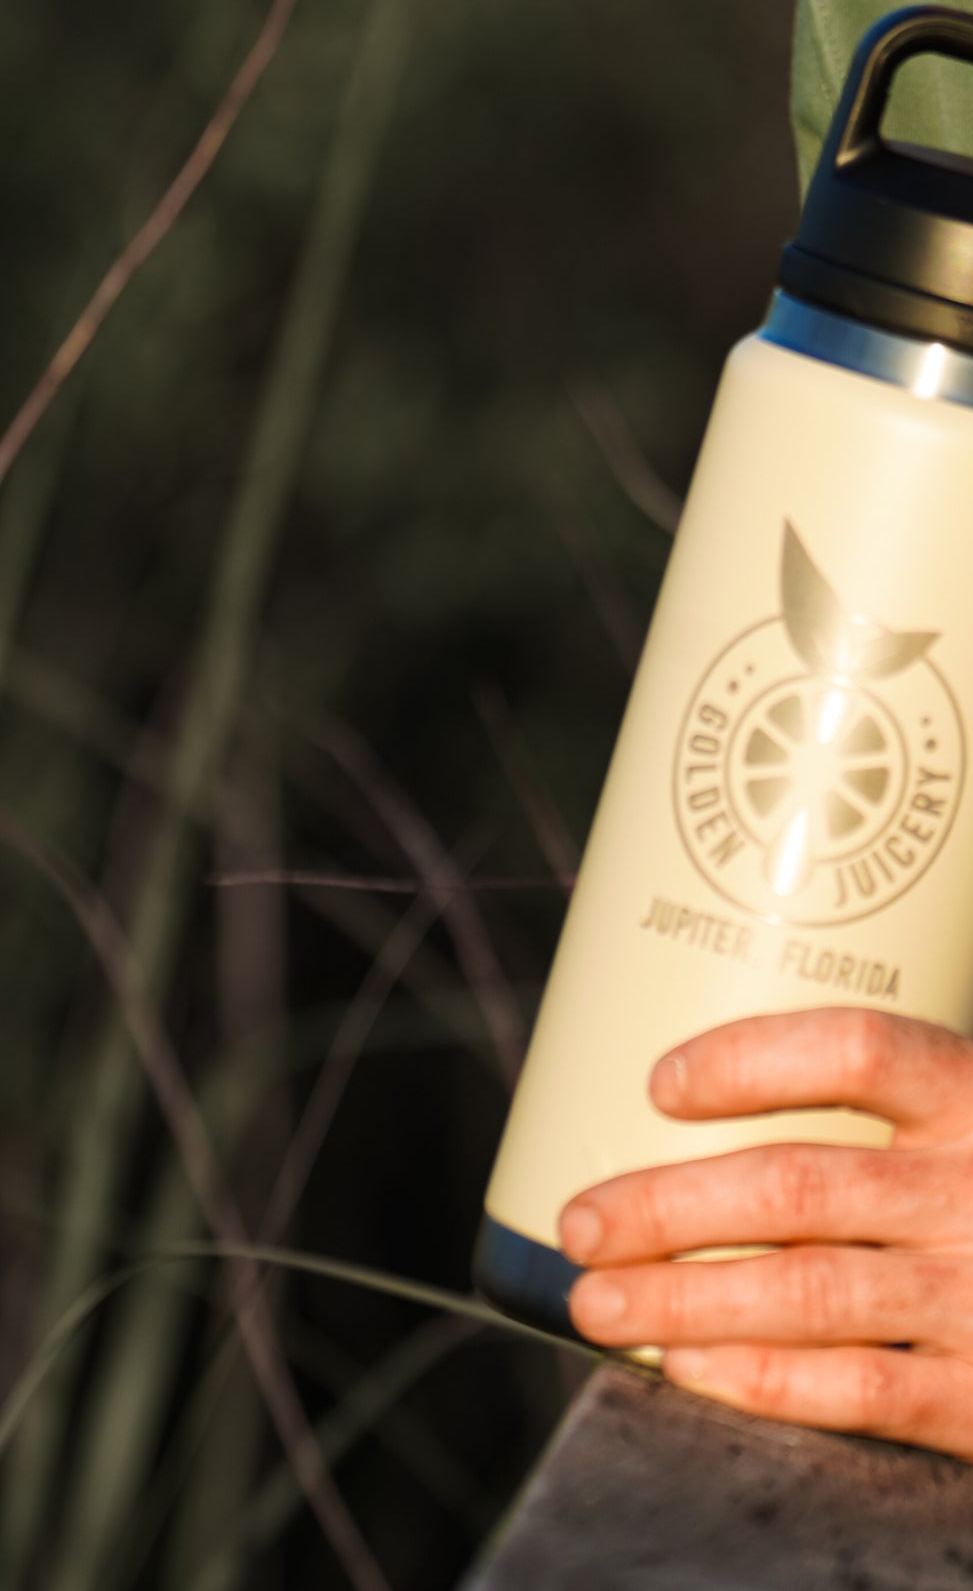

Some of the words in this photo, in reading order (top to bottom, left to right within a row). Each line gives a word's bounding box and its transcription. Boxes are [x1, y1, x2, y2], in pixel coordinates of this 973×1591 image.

[685, 703, 746, 868] GOLDEN
[834, 766, 953, 908] JUICERY
[781, 939, 902, 1000] FLORIDA
